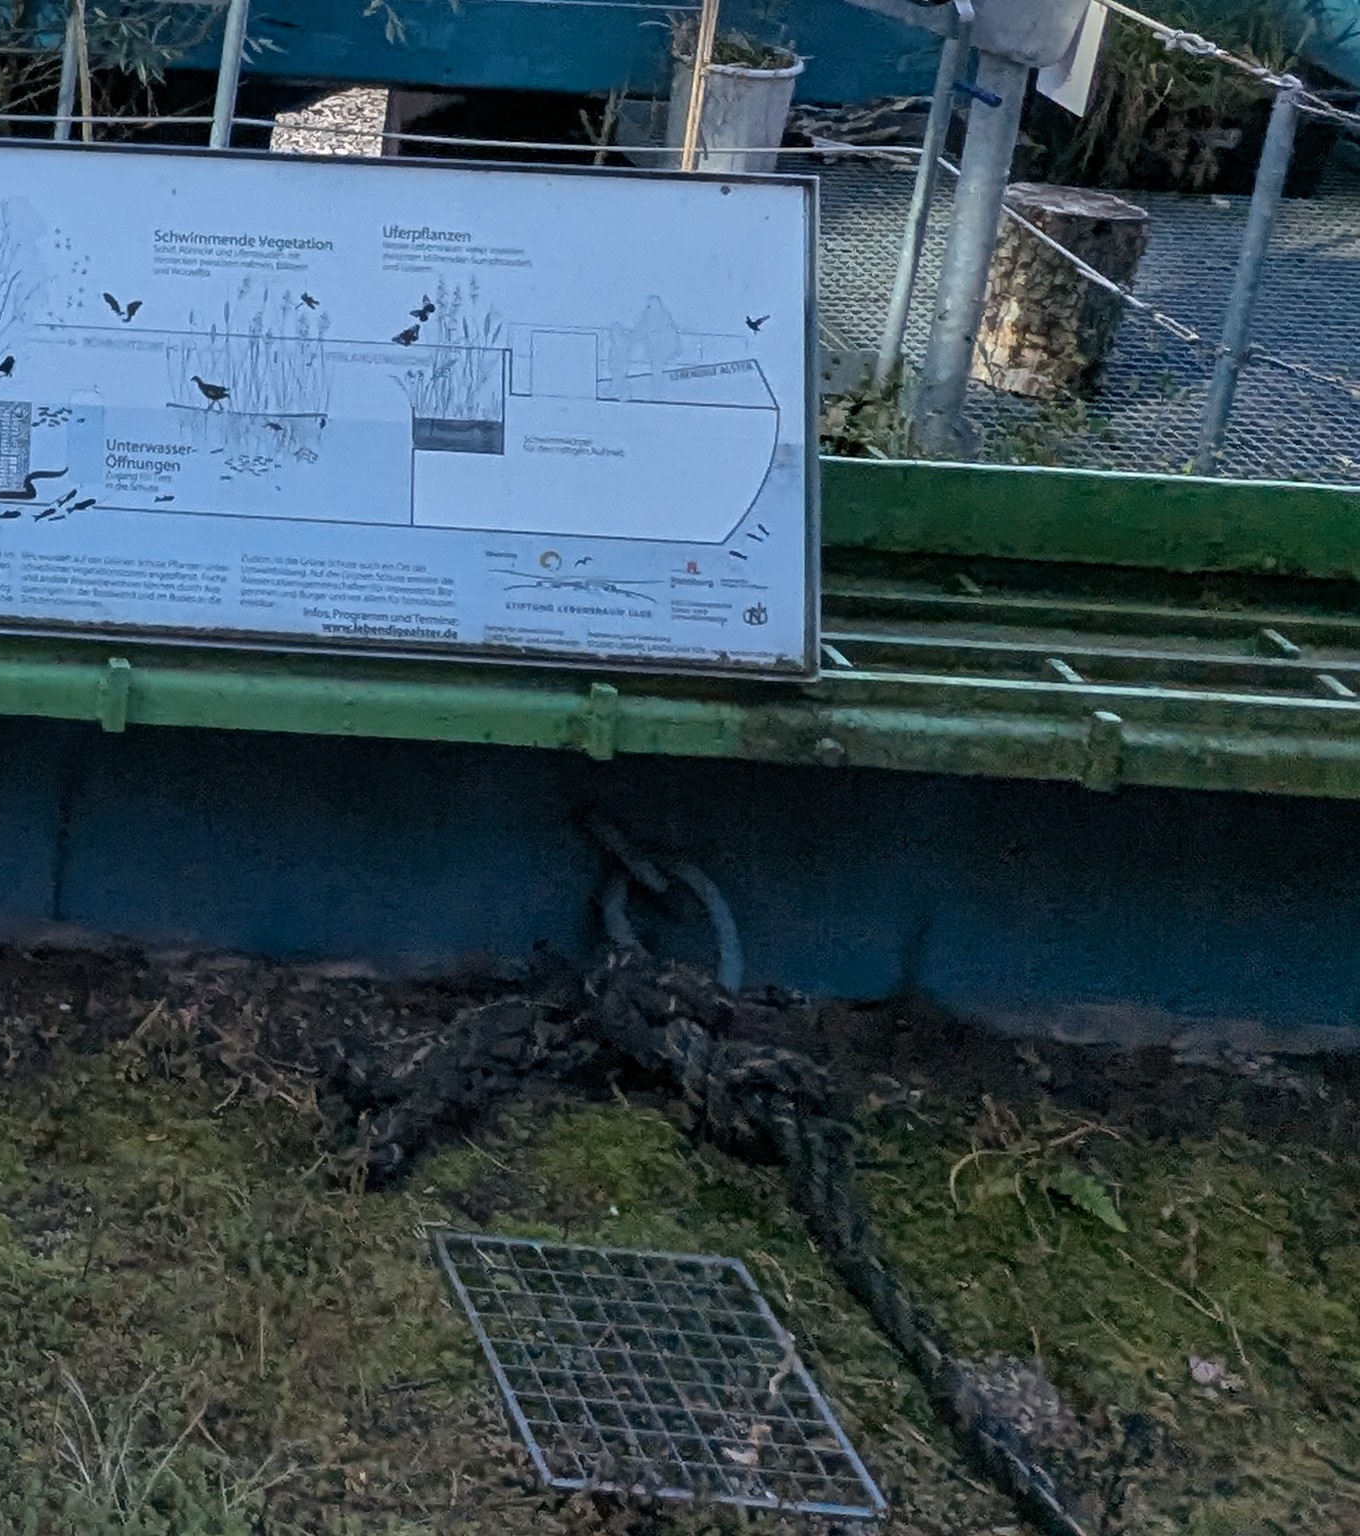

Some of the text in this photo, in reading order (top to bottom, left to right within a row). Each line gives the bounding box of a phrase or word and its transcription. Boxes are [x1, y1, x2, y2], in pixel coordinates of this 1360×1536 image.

[154, 230, 334, 251] Schwimmende Vegetation
[382, 225, 472, 243] Uferpflanzen
[106, 438, 198, 455] Unterwasser-
[105, 452, 181, 473] Öffnungen
[391, 612, 413, 624] und
